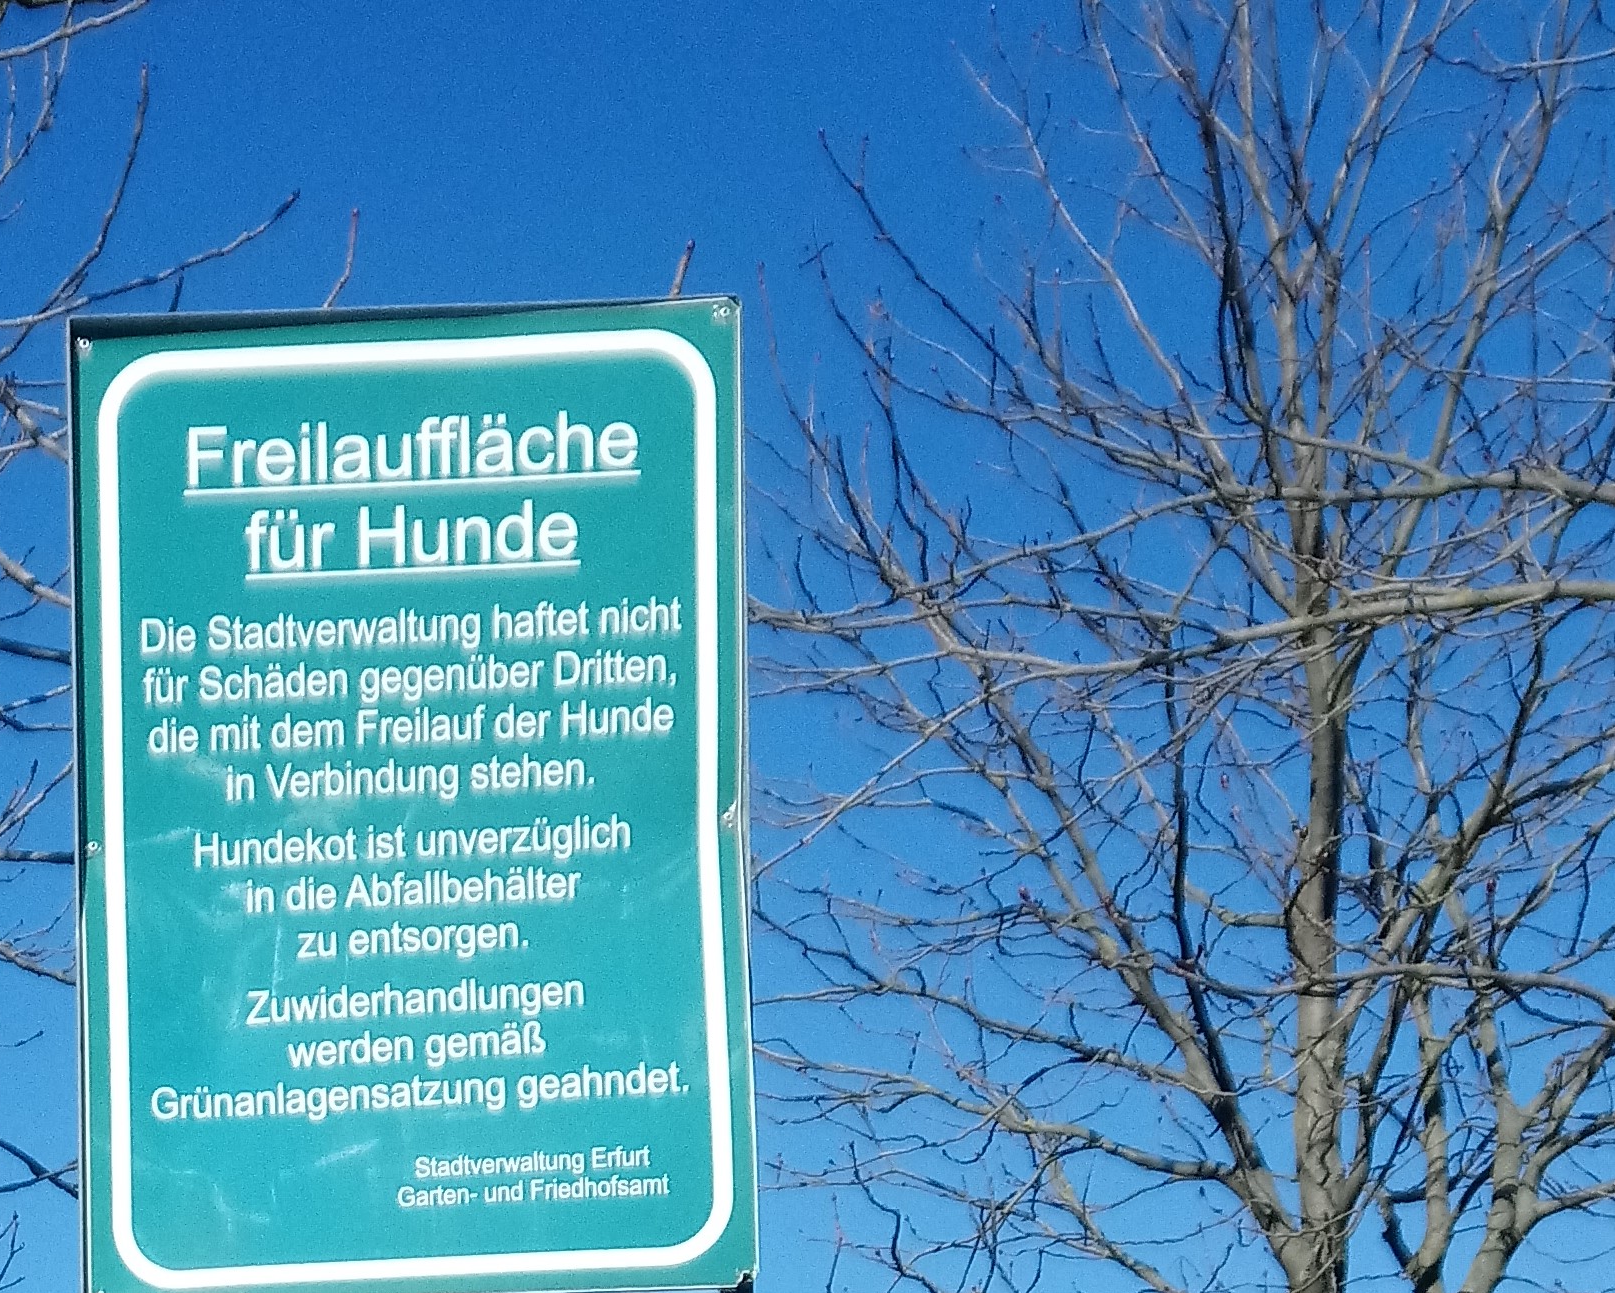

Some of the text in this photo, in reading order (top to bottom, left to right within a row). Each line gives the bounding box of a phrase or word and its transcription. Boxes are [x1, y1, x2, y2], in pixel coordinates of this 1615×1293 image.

[185, 410, 640, 488] Freilauffläche
[244, 500, 579, 574] für Hunde
[140, 597, 681, 654] Die Stadtverwaltung haftet nicht
[143, 651, 677, 706] für Schäden gegenüber Dritten,
[148, 699, 675, 754] die mit dem Freilauf der Hunde
[226, 754, 596, 802] in Verbindung stehen.
[193, 816, 631, 868] Hundekot ist unverzüglich
[246, 868, 581, 914] in die Abfallbehälter
[297, 920, 530, 961] zu entsorgen.
[245, 978, 585, 1026] Zuwiderhandlungen
[288, 1022, 547, 1068] werden gemäß
[149, 1062, 691, 1122] Grünanlagensatzung geahndet.
[414, 1146, 651, 1179] Stadtverwaltung Erfurt
[397, 1175, 670, 1208] Garten- und Friedhofsamt
